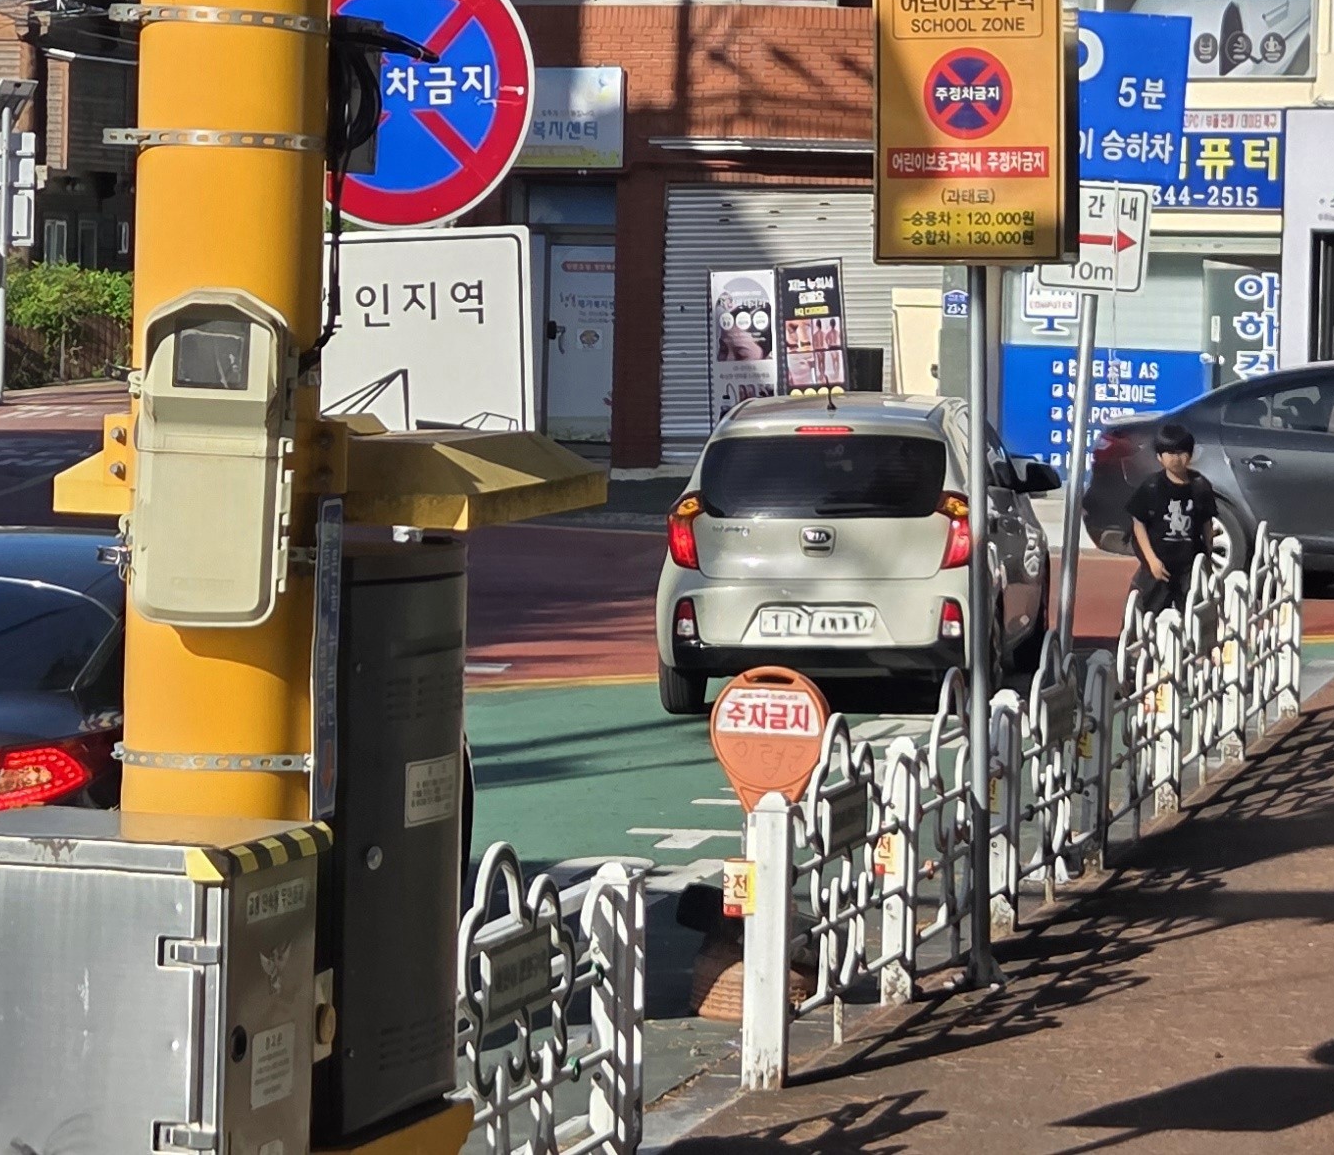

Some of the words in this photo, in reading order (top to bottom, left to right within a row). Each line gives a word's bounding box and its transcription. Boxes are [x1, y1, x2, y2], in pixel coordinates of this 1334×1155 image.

[910, 18, 977, 33] SCHOOL
[982, 17, 1026, 32] ZONE
[386, 64, 491, 105] 차금지
[935, 86, 1000, 102] 주정차금지
[1118, 77, 1166, 110] 5분
[1101, 129, 1175, 165] 승하차
[892, 151, 982, 173] 어린이보호구역내
[987, 151, 1046, 174] 주정차금지
[941, 188, 996, 205] (과태료)
[1069, 261, 1114, 281] 10m
[1138, 361, 1160, 380] AS
[726, 701, 811, 732] 주차금지
